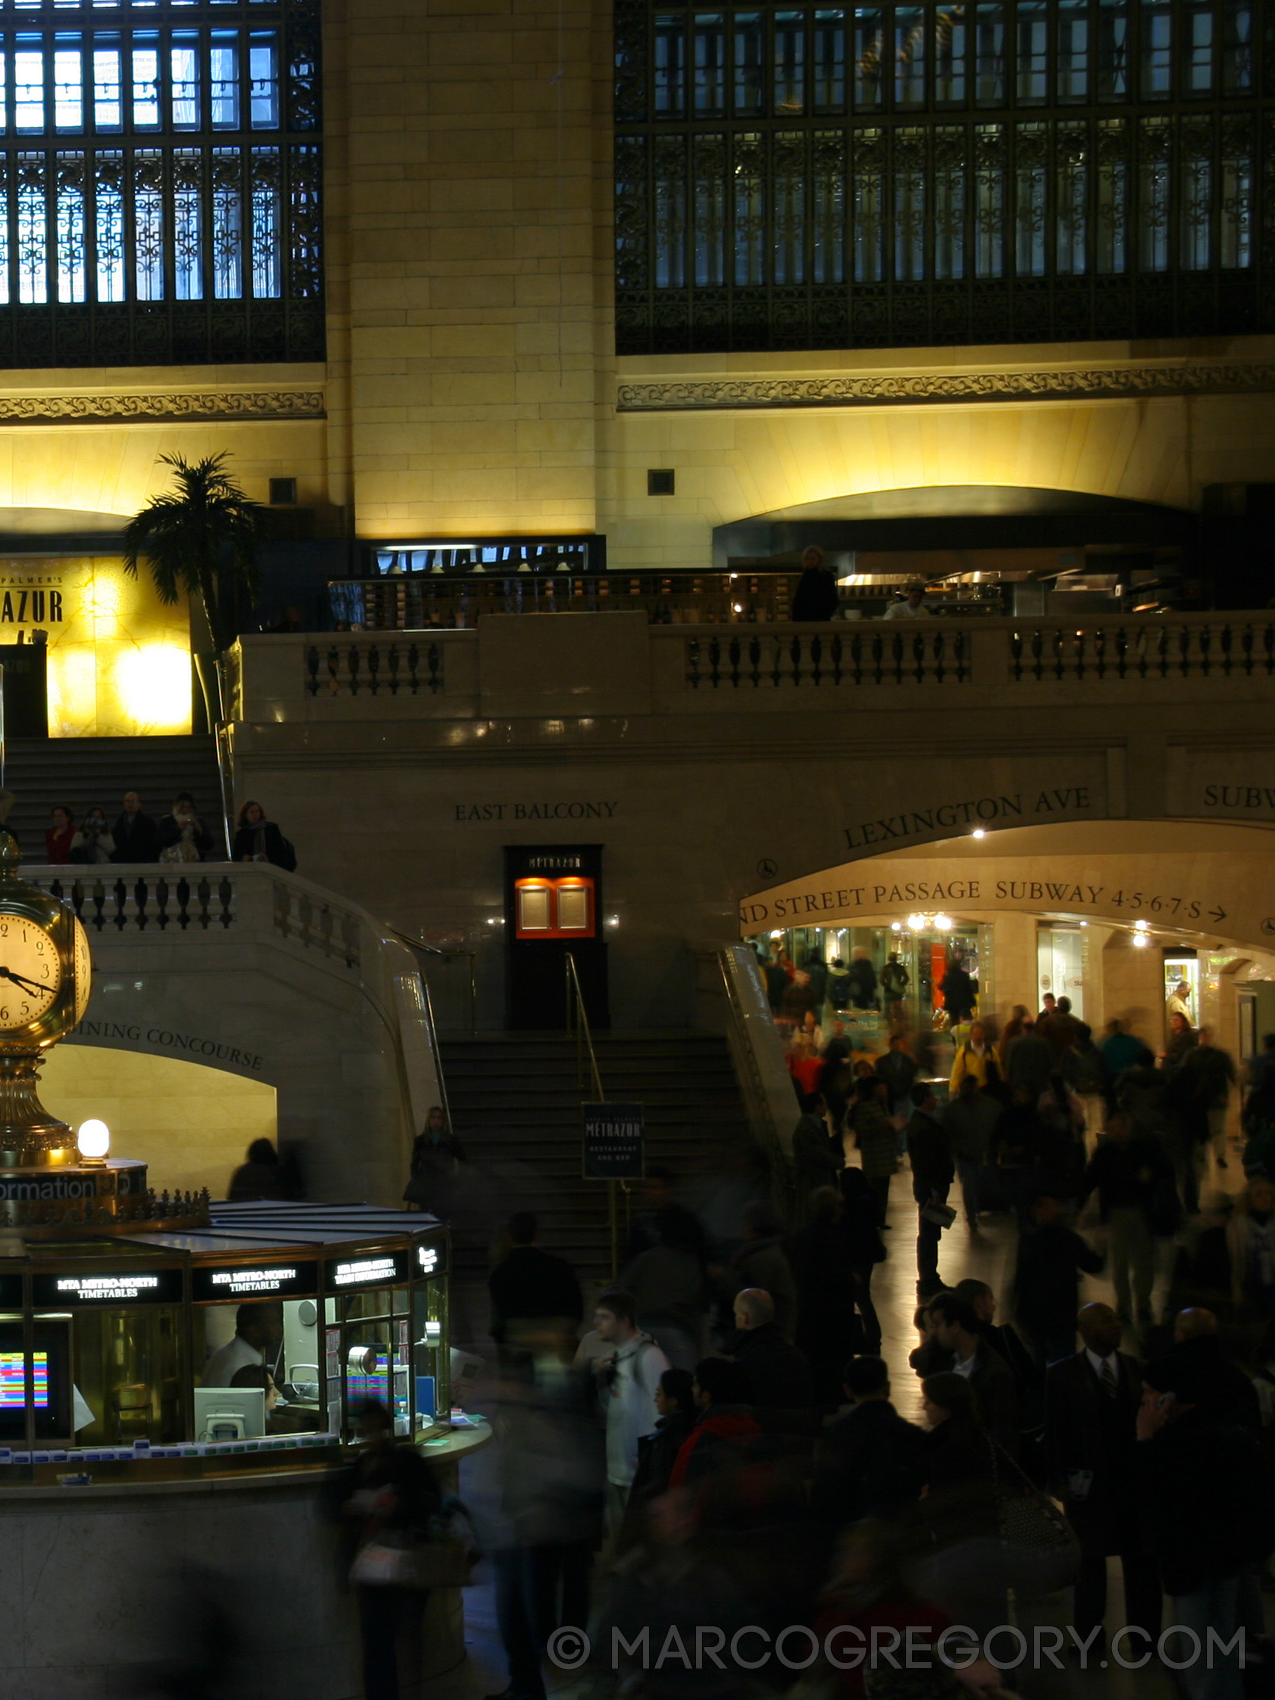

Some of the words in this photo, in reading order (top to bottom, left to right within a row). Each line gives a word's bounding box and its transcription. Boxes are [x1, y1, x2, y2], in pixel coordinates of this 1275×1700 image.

[1, 576, 62, 584] PALMER'S
[455, 804, 507, 821] EAST
[514, 801, 619, 820] BALCONY
[845, 793, 1022, 849] LEXINGTON
[1034, 787, 1090, 813] AVE
[774, 887, 865, 918] STREET
[874, 880, 981, 903] PASSAGE
[996, 880, 1104, 904] SUBWAY
[22, 929, 27, 943] 1
[36, 942, 45, 956] 2
[41, 963, 50, 980] 3
[0, 1006, 9, 1020] 6
[20, 1001, 29, 1015] 5
[72, 1020, 140, 1041] INING
[147, 1028, 264, 1071] CONCOURSE
[77, 1288, 138, 1299] TIMETABLES
[229, 1281, 280, 1292] TIMETABLES
